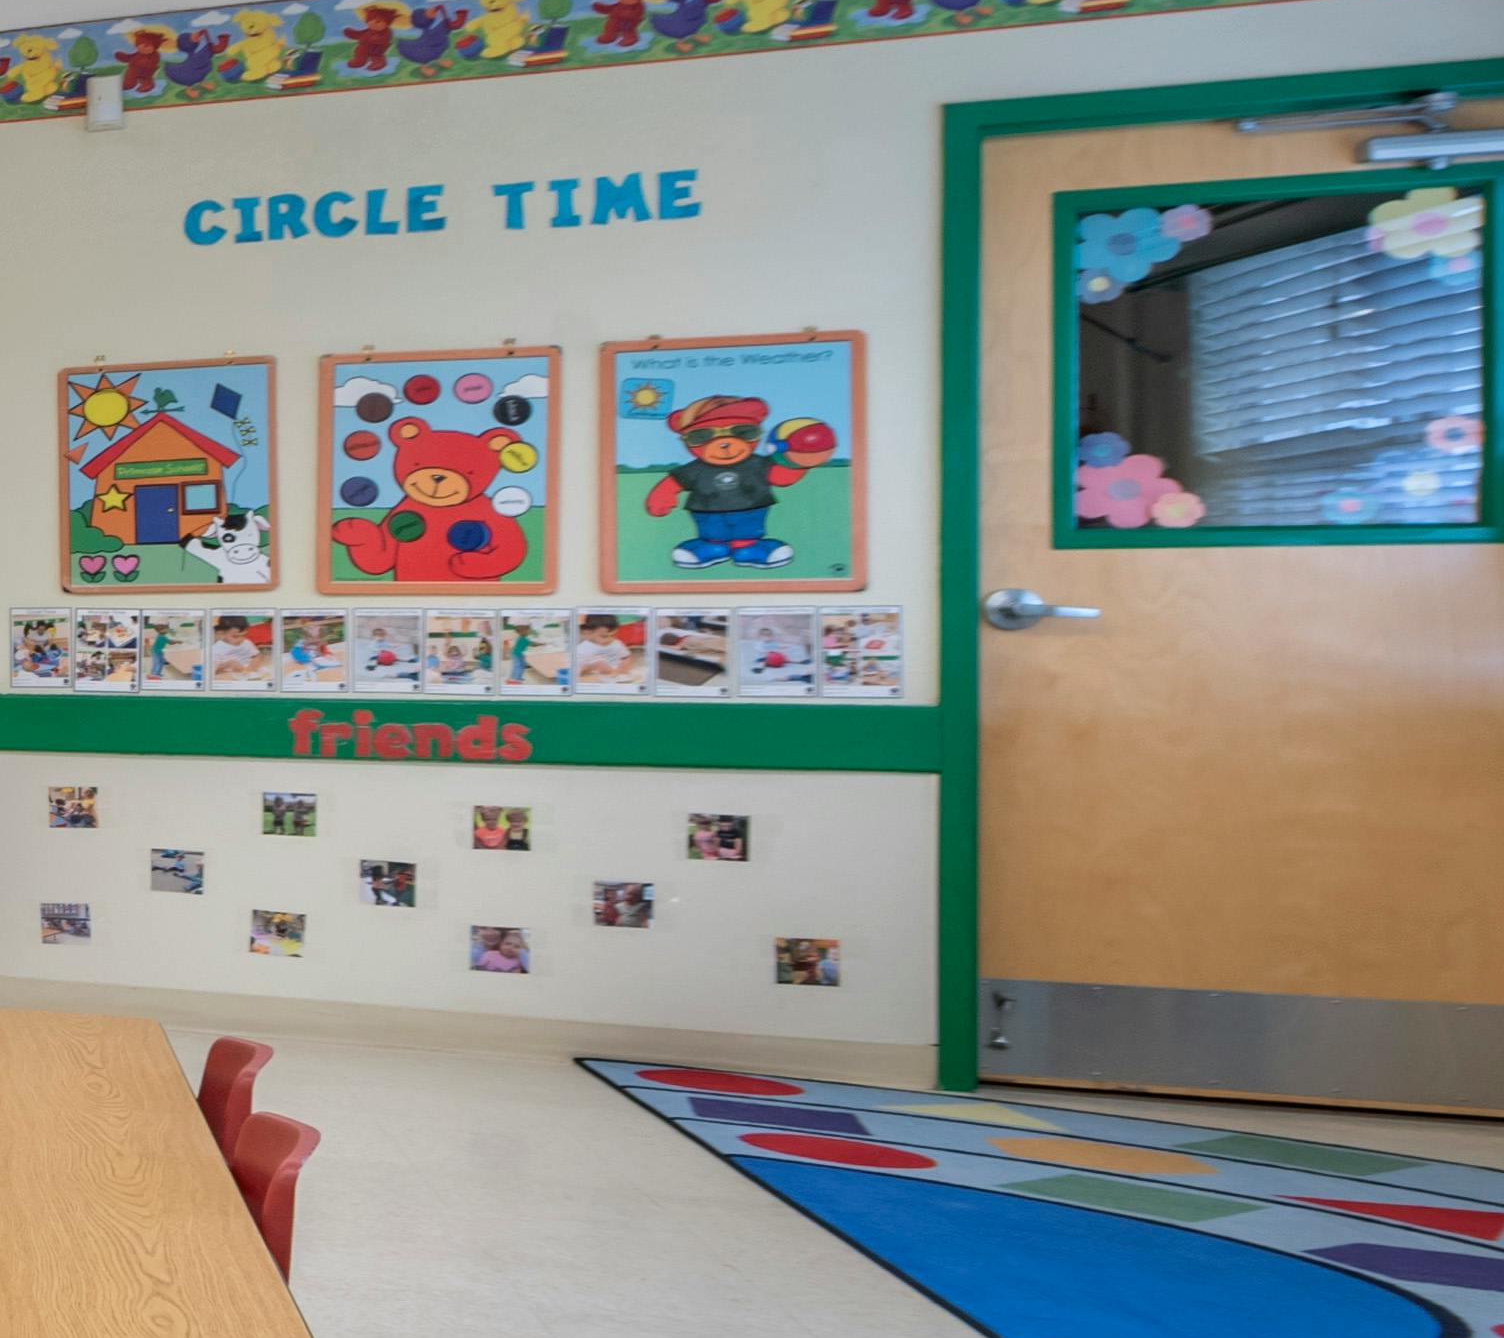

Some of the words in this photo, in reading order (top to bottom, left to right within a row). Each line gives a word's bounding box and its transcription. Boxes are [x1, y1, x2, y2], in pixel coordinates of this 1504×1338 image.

[183, 183, 447, 246] CIRCLE
[492, 168, 703, 230] TIME
[631, 357, 681, 370] What
[685, 356, 699, 368] is
[705, 354, 736, 367] the
[740, 349, 834, 366] Weather?
[288, 708, 533, 761] friends
